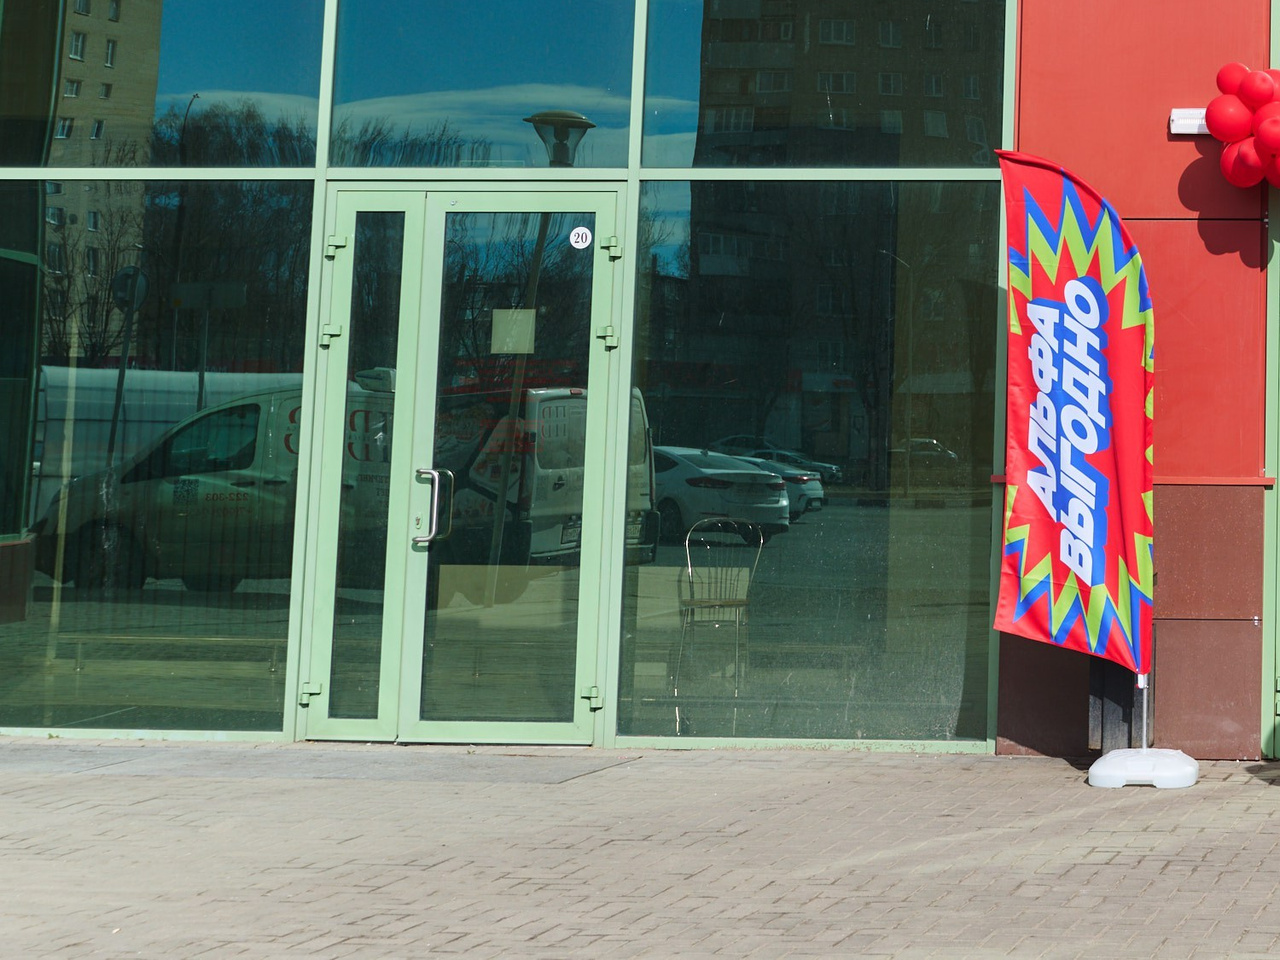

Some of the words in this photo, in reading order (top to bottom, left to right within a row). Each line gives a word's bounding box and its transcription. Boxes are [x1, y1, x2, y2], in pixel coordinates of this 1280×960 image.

[574, 232, 588, 244] 20
[1026, 302, 1060, 523] АЛЬФА
[1059, 279, 1107, 588] ВЫГОДНО
